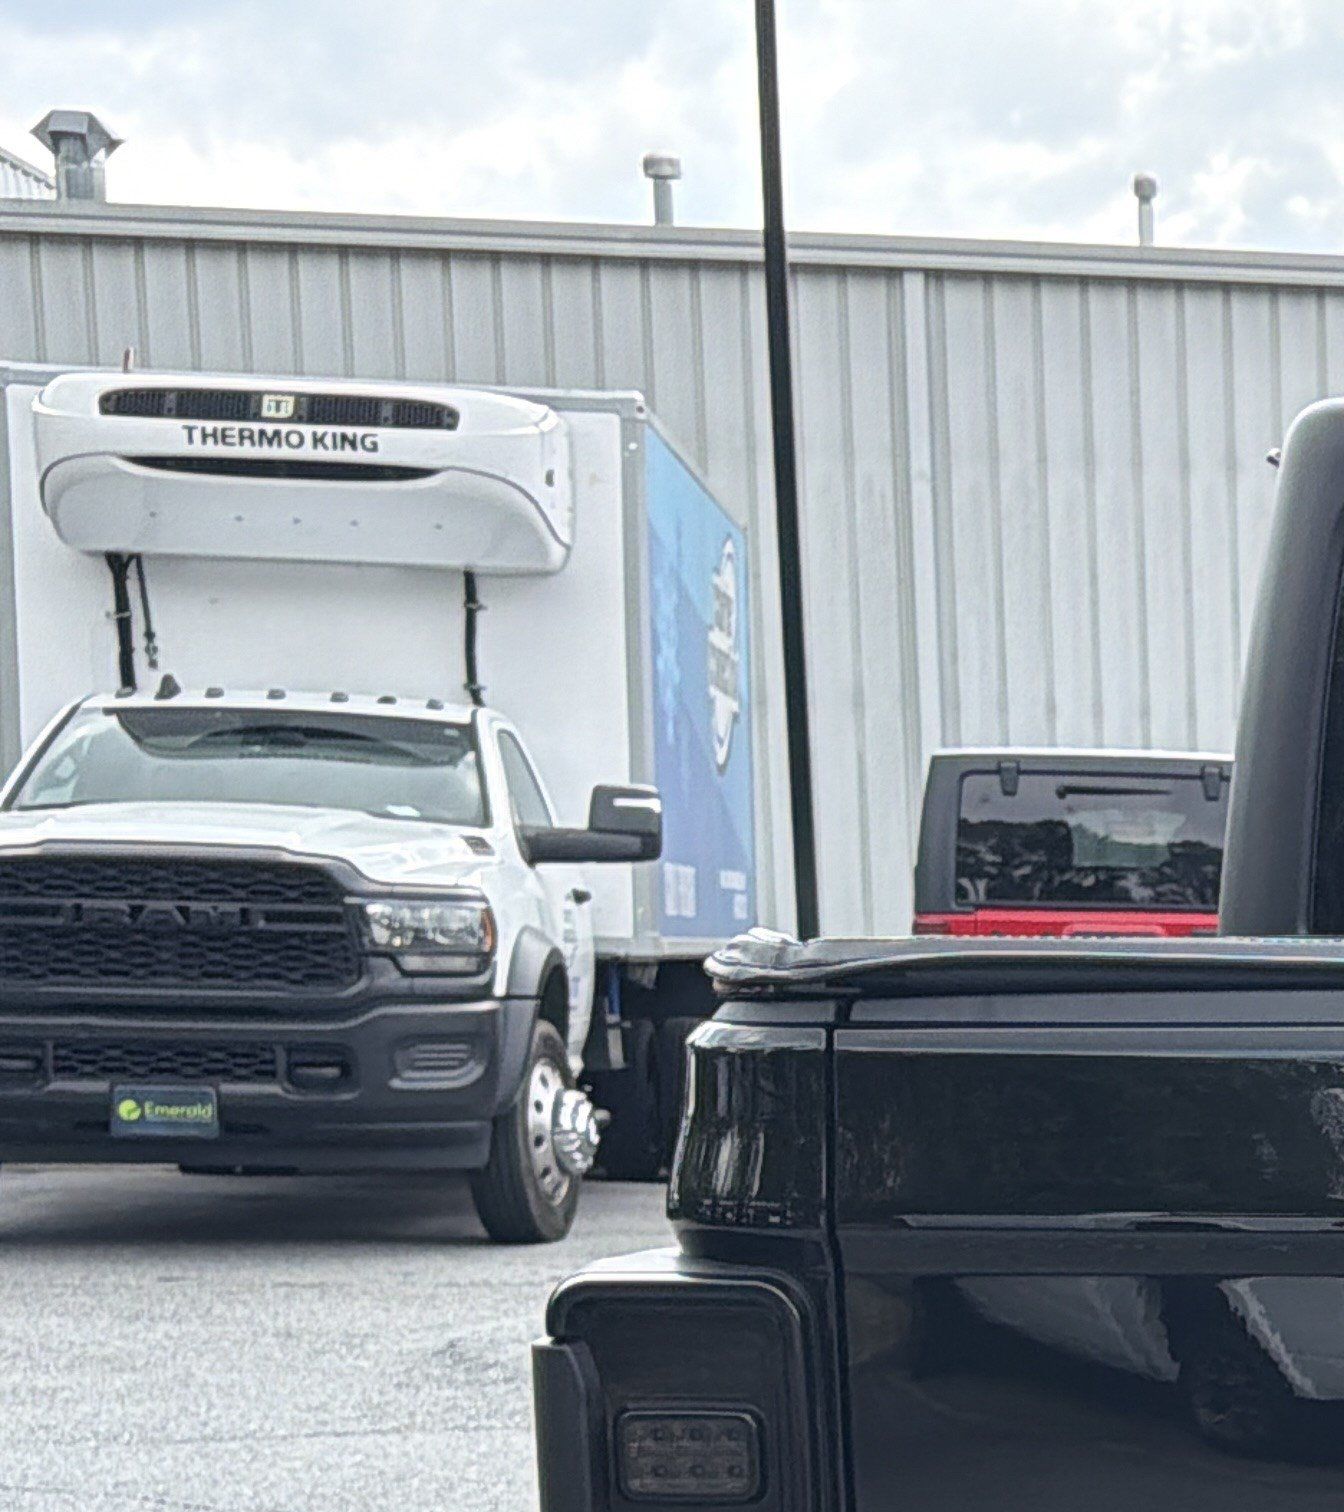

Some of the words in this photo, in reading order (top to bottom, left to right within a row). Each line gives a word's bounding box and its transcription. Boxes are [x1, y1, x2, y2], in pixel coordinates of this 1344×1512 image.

[182, 424, 305, 450] THERMO
[311, 430, 379, 453] KING
[144, 1100, 212, 1122] Emerald
